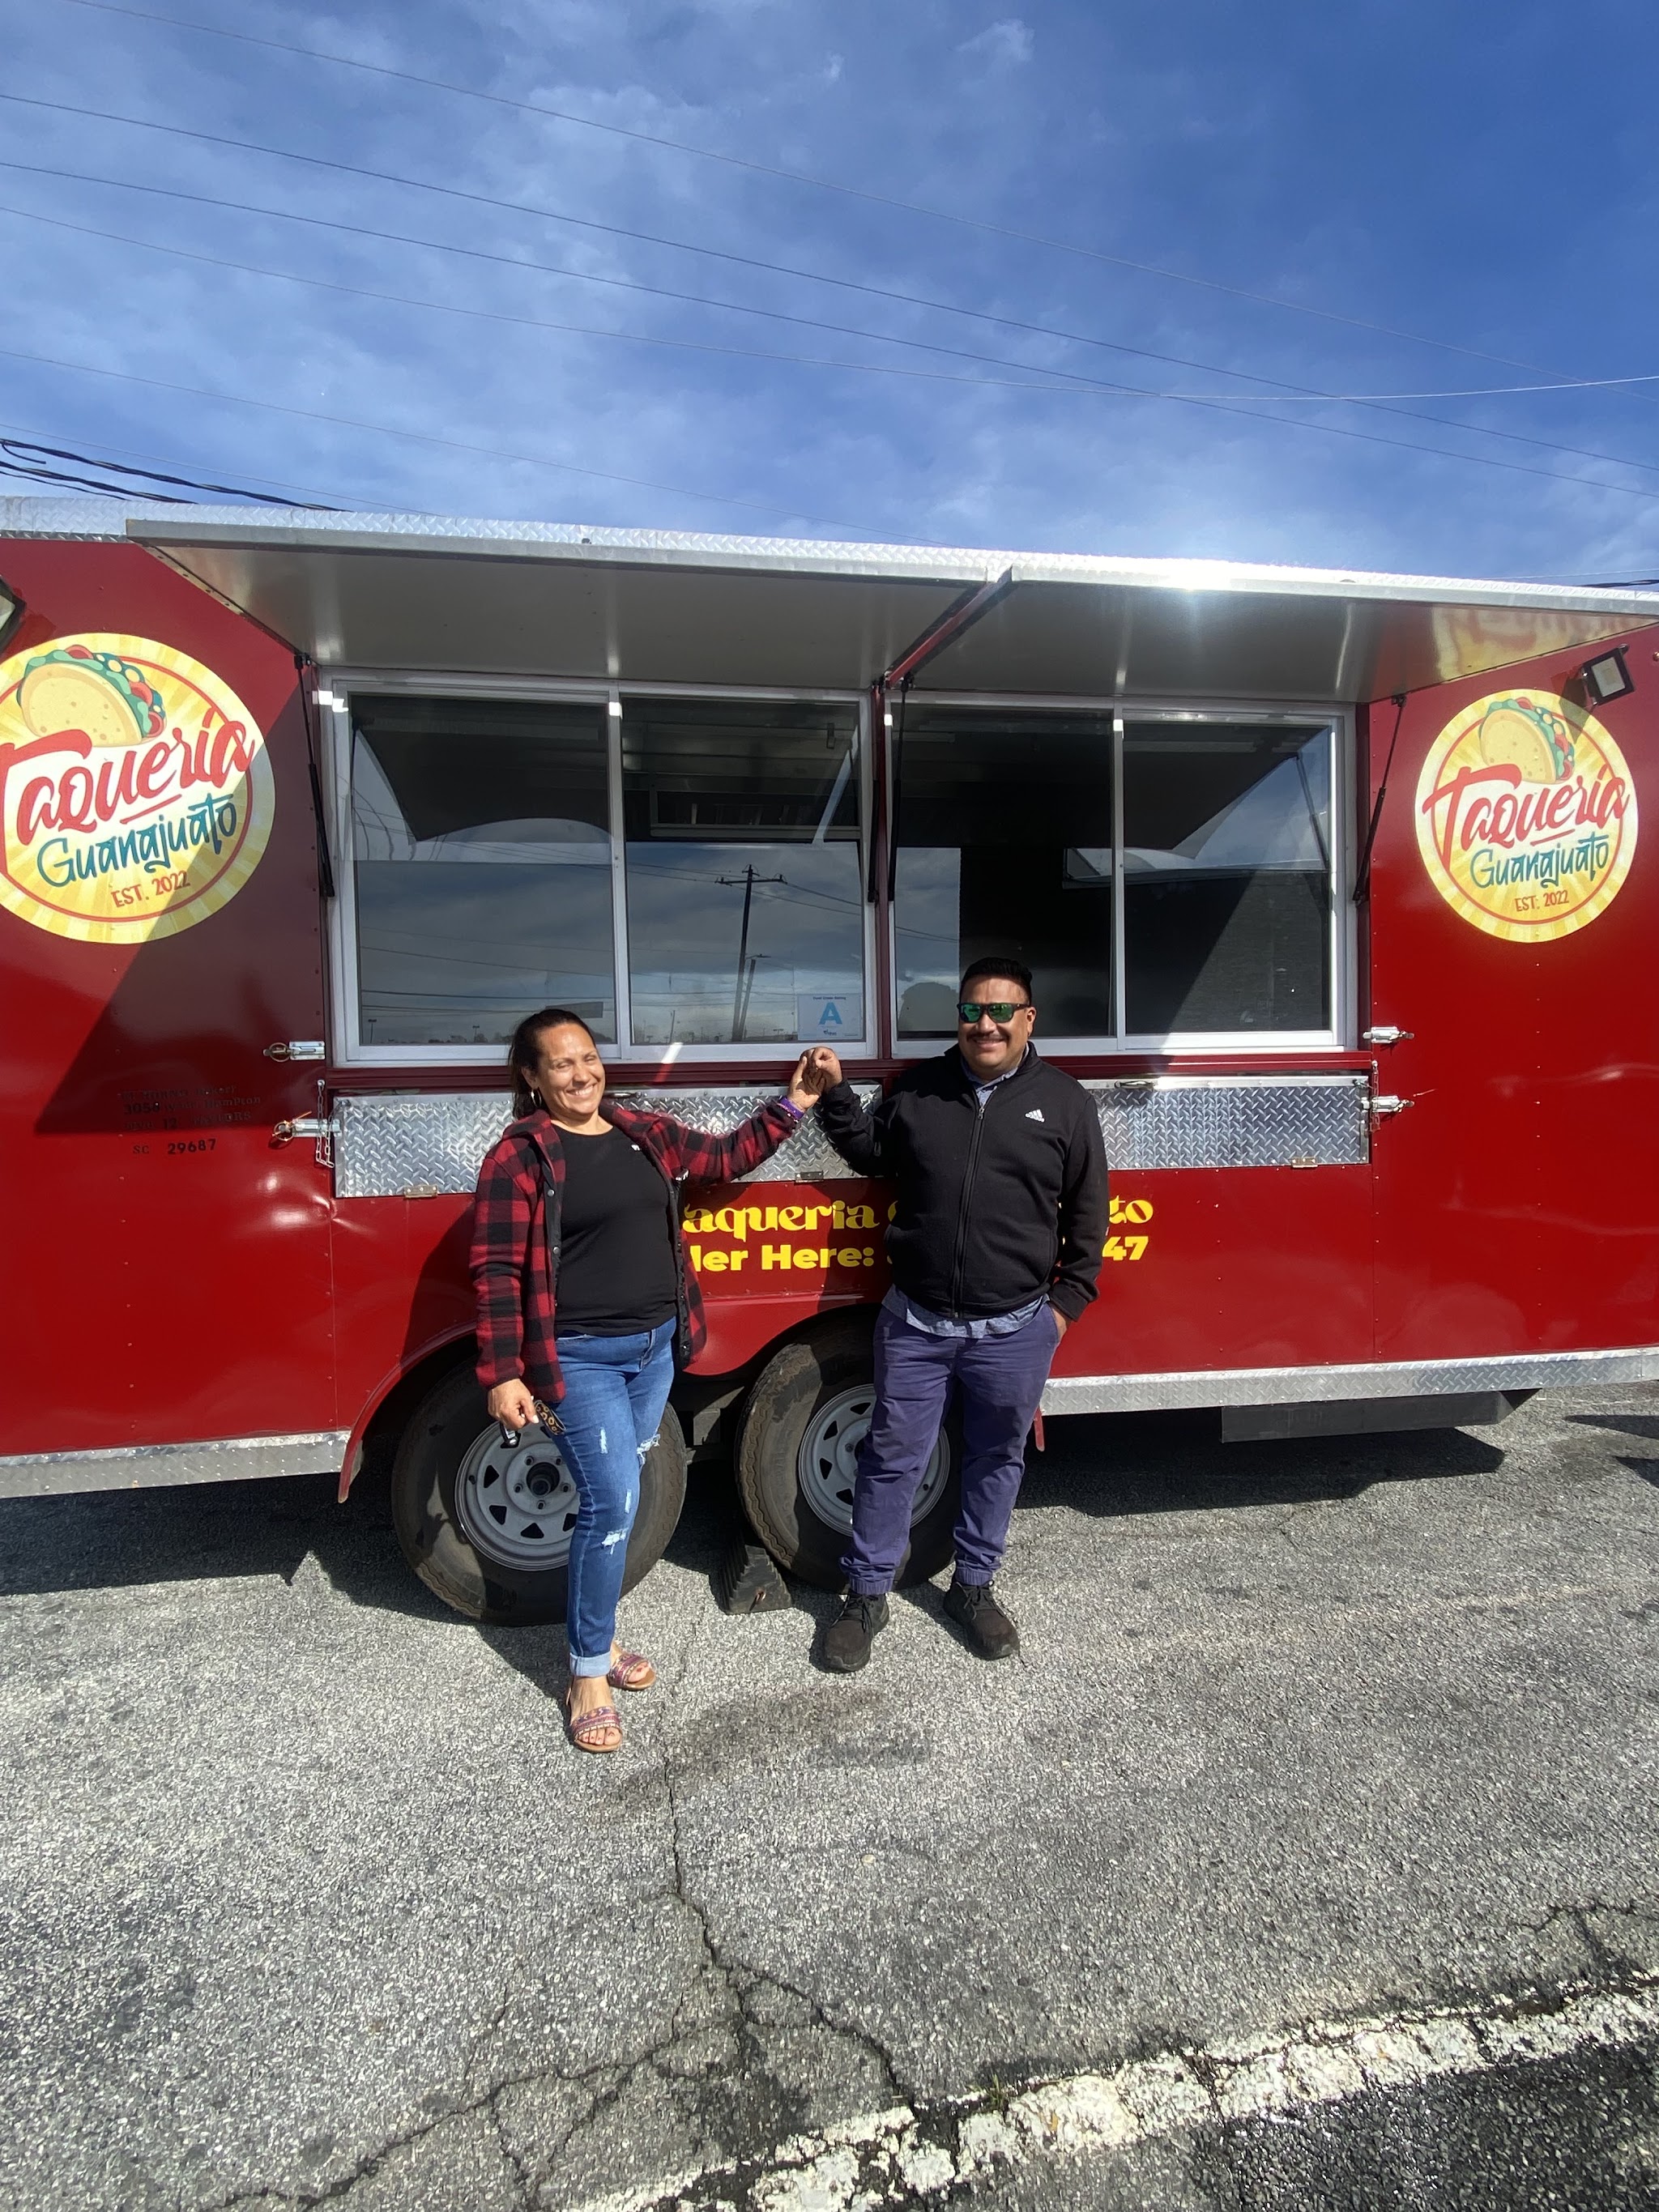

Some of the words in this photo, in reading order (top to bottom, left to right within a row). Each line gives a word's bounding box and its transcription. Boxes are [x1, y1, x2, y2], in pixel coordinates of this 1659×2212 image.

[37, 792, 237, 888] Guanajuato
[1469, 832, 1610, 889] Guanajuato
[111, 890, 149, 908] EST.
[151, 870, 190, 896] 2022
[1543, 889, 1570, 907] 2022
[818, 1002, 842, 1025] A
[133, 1144, 149, 1154] SC
[168, 1138, 216, 1155] 29687
[682, 1200, 880, 1242] aqueria
[761, 1244, 875, 1270] Here:
[1102, 1236, 1149, 1260] 47
